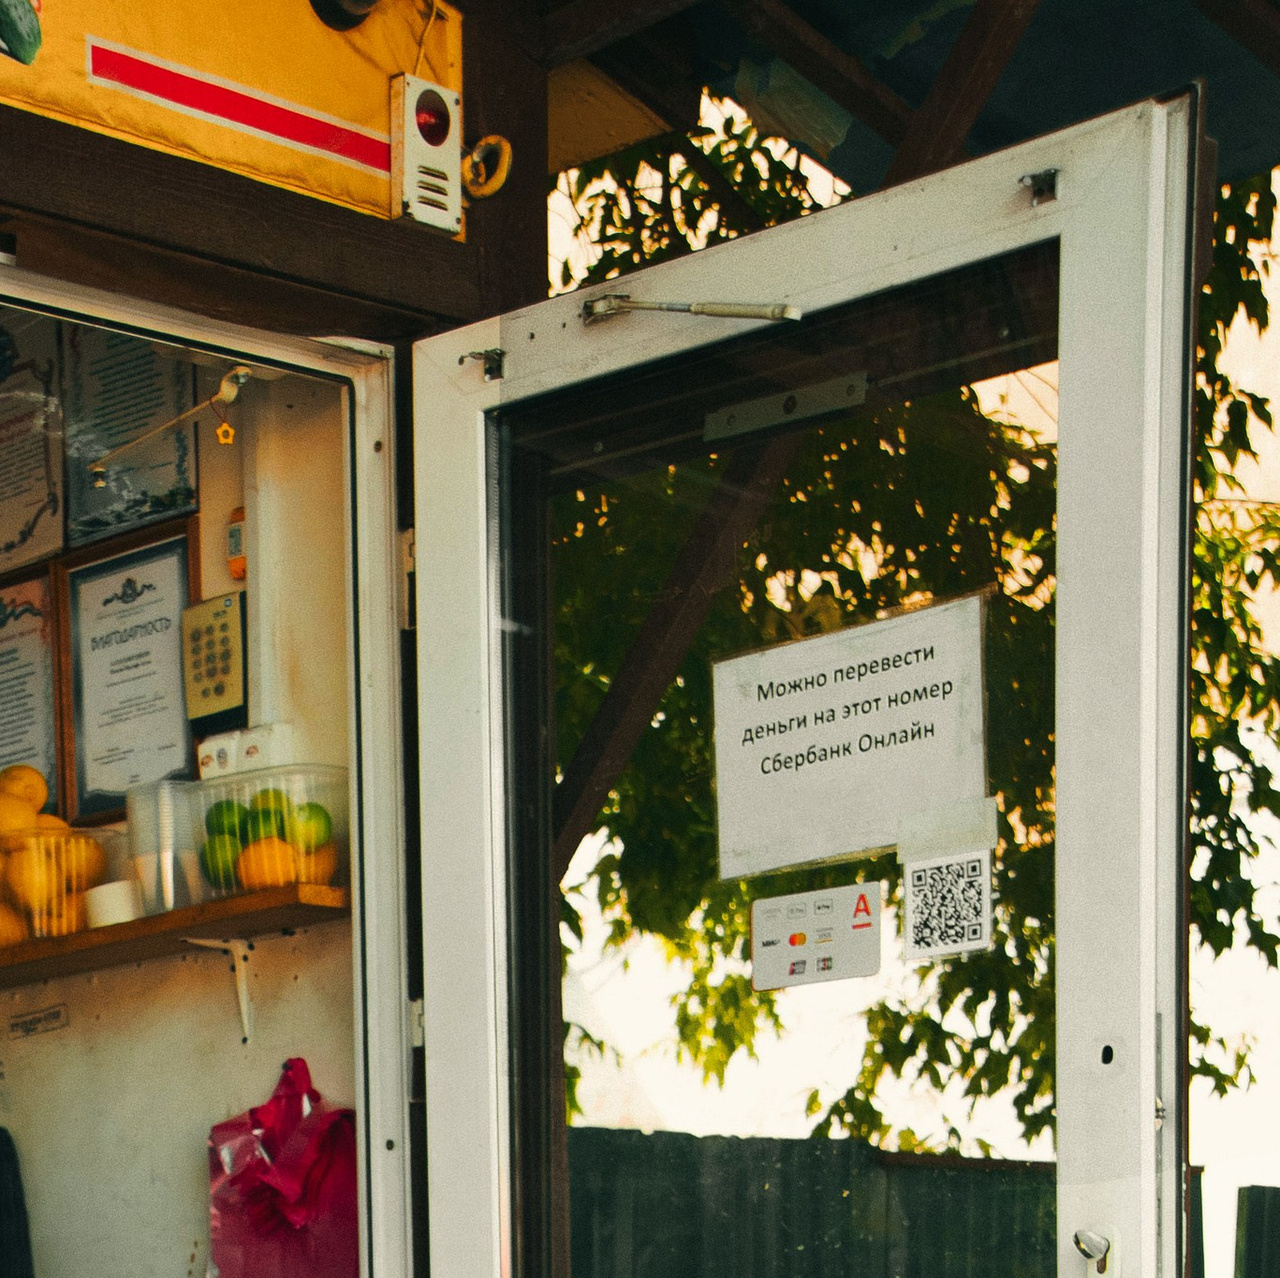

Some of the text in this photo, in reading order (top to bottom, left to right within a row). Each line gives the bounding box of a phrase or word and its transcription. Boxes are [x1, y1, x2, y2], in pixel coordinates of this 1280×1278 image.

[757, 646, 935, 702] Можно перевести
[741, 680, 953, 746] деньги на этот номер
[760, 721, 935, 775] Сбербанк Онлайн
